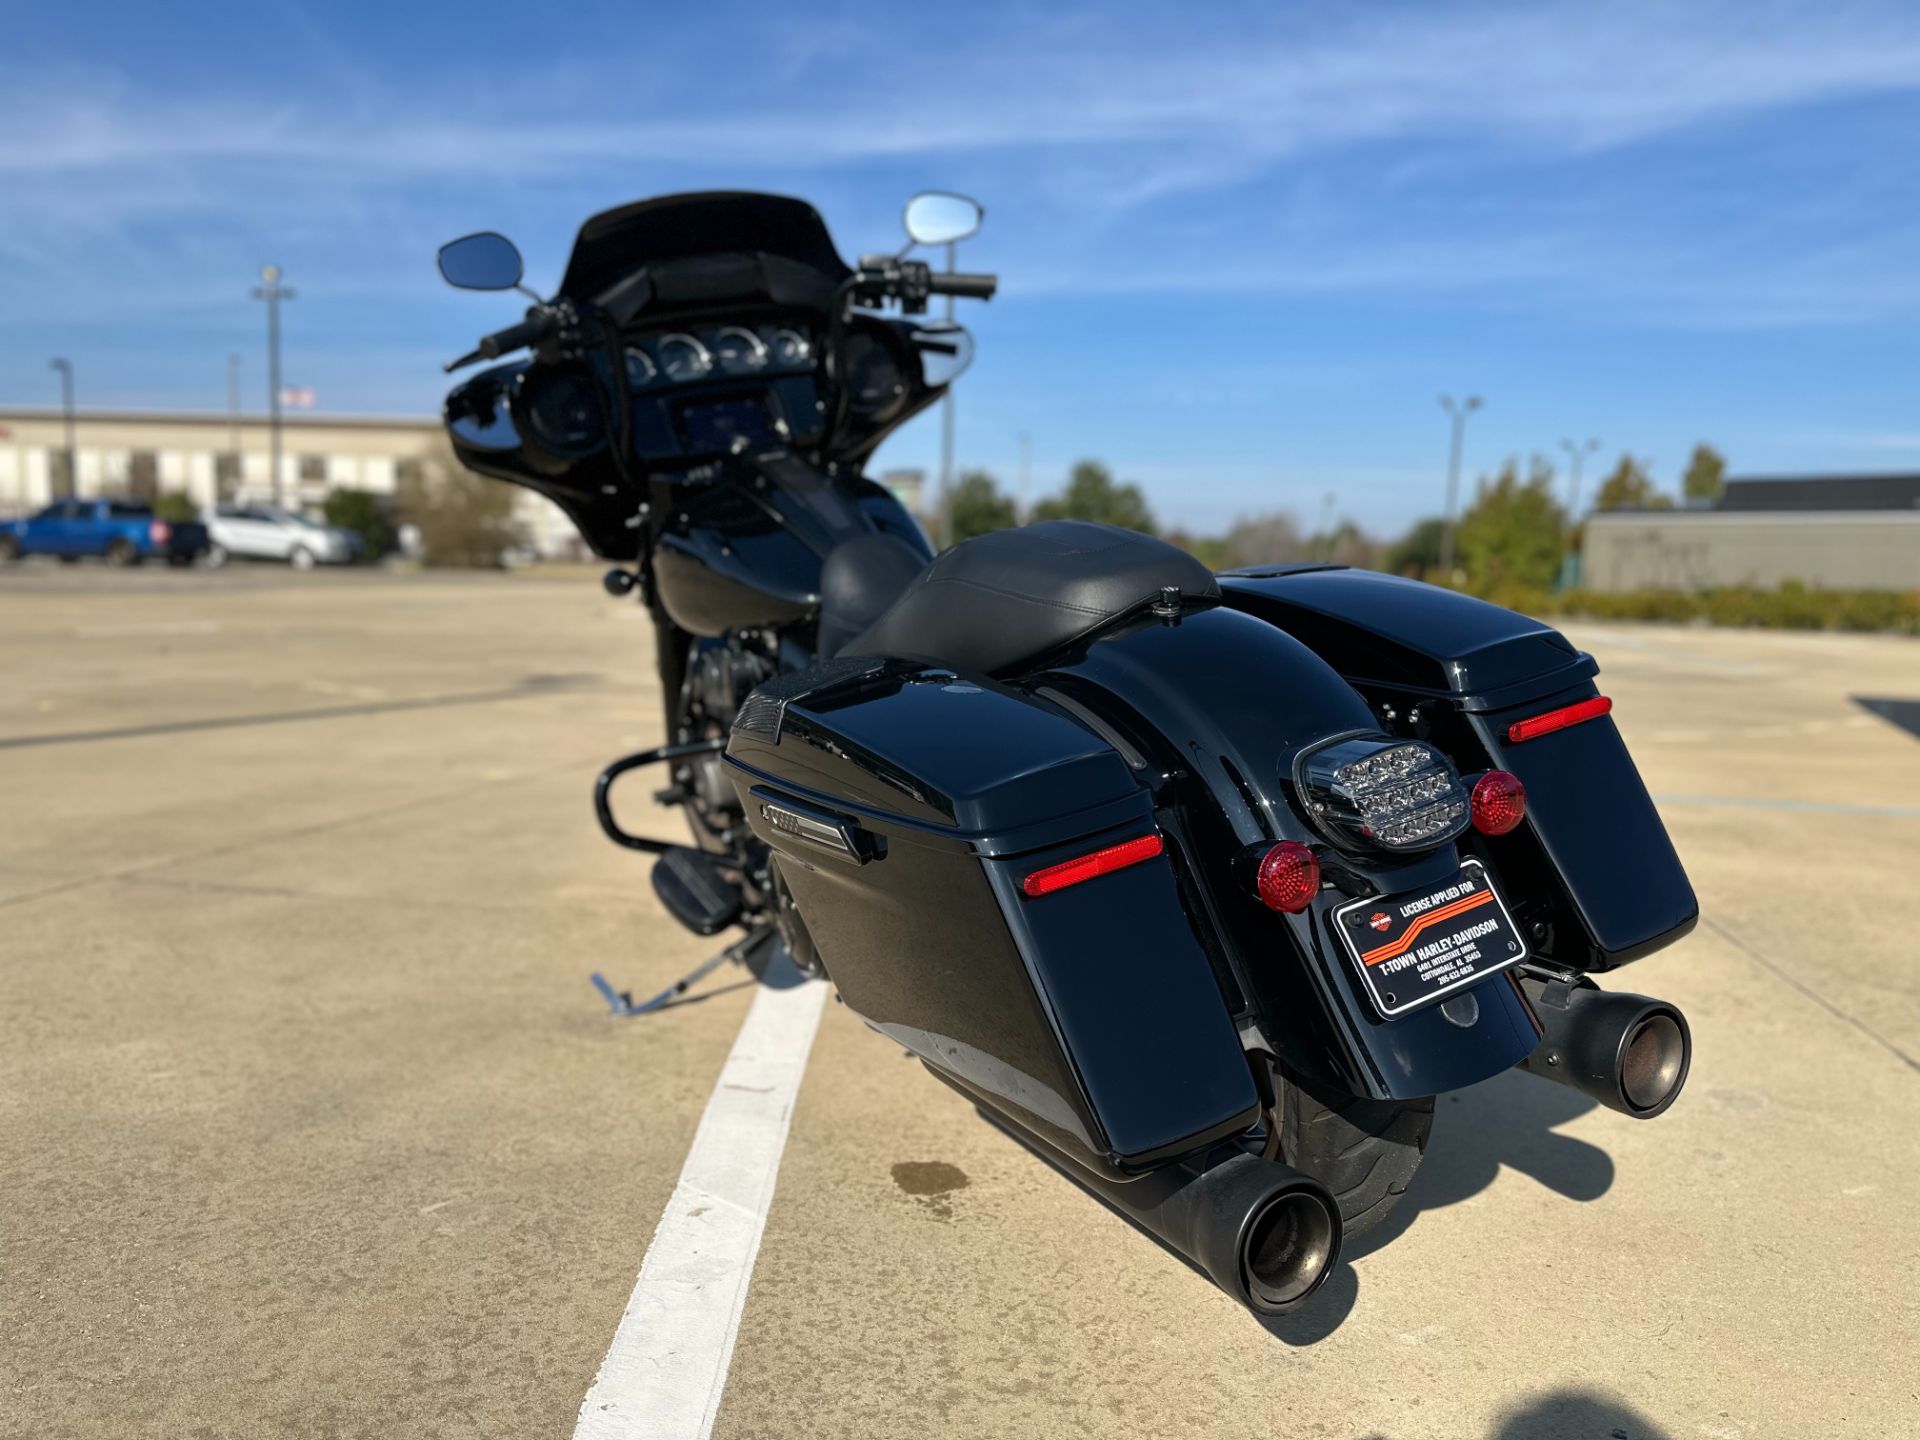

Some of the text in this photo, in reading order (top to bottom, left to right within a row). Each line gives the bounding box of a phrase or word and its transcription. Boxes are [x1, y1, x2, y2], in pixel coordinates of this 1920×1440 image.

[1400, 881, 1475, 917] LICENSE APPLIED FOR
[1379, 952, 1417, 976] T-TOWN
[1416, 918, 1499, 961] HARLEY-DAVIDSON
[1430, 948, 1461, 967] INTERSTATE
[1460, 942, 1477, 954] DRIVE
[1455, 958, 1464, 967] AL
